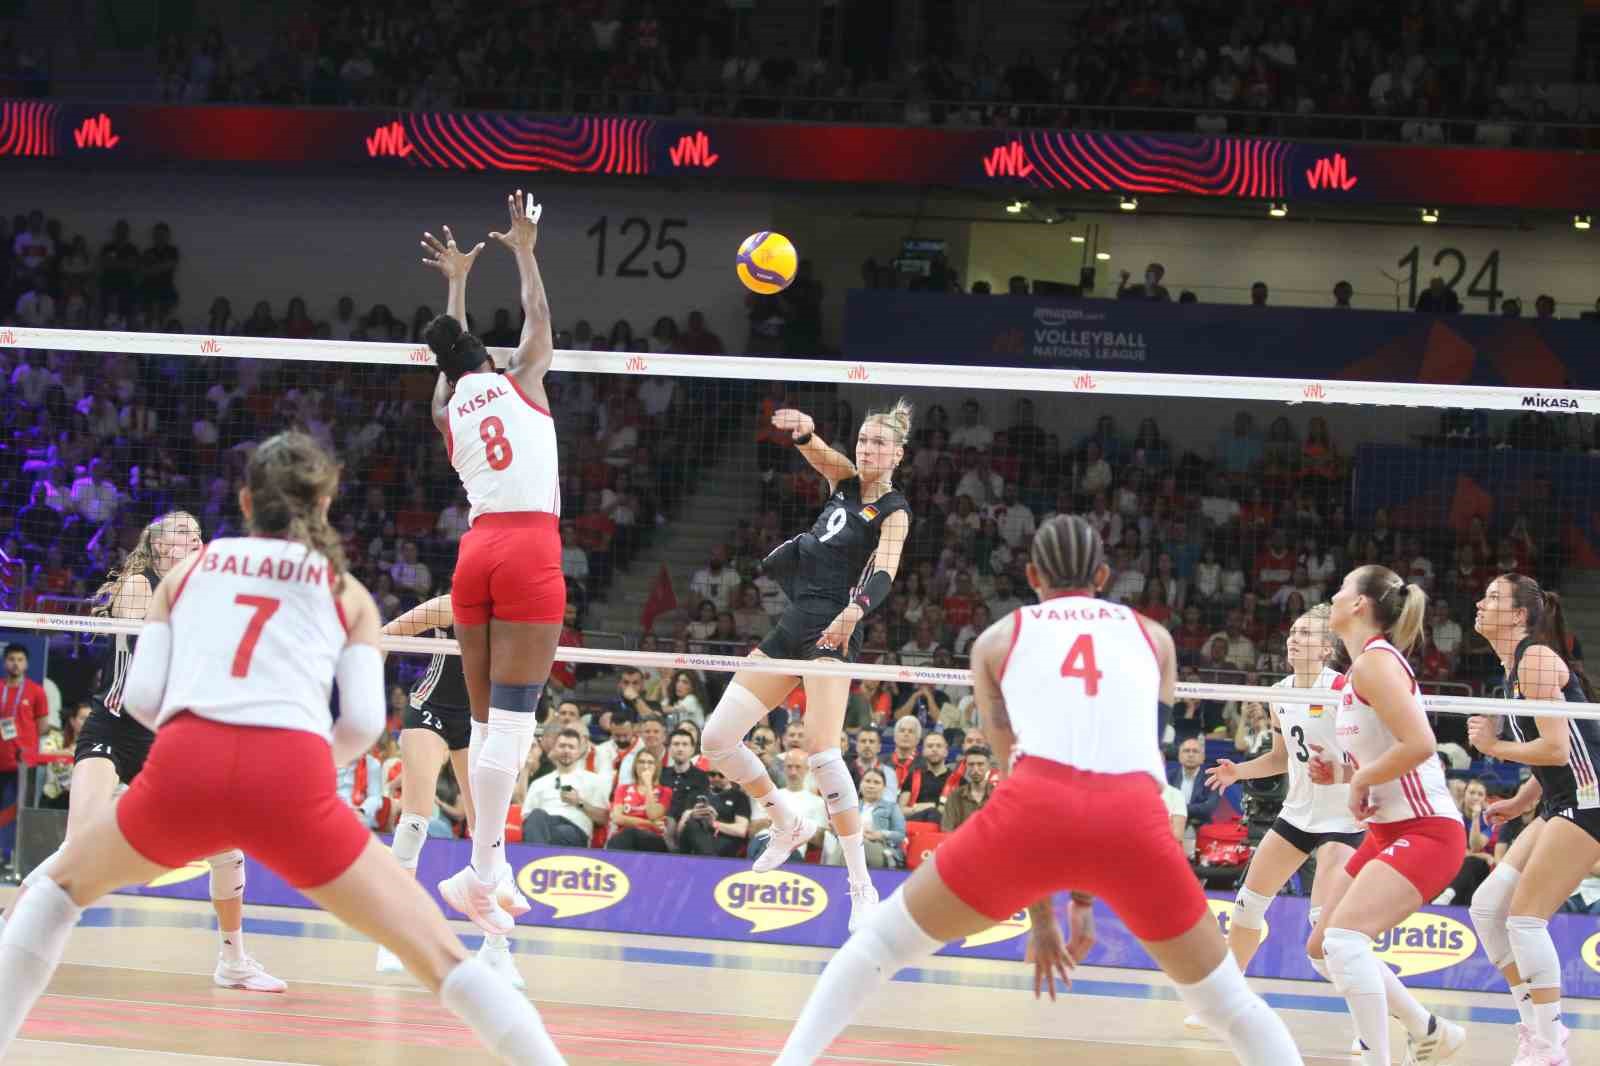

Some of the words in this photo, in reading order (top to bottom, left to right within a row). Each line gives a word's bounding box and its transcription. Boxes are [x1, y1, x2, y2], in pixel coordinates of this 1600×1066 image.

[73, 113, 120, 149] VNL
[366, 121, 413, 157] VNL
[669, 131, 719, 168] VNL
[984, 140, 1034, 177] VNL
[1306, 153, 1358, 190] VNL
[587, 216, 688, 279] 125
[1396, 244, 1504, 312] 124
[1032, 345, 1091, 359] NATIONS
[1095, 349, 1147, 361] LEAGUE
[1033, 328, 1147, 348] VOLLEYBALL
[457, 386, 509, 417] KISAL
[480, 416, 513, 471] 8
[819, 507, 847, 543] 9
[1030, 607, 1127, 620] VARGAS
[231, 594, 281, 678] 7
[1060, 633, 1103, 697] 4
[421, 710, 443, 730] 23
[1290, 725, 1310, 763] 3
[530, 865, 617, 894] gratis
[727, 879, 815, 909] gratis
[1373, 921, 1464, 952] gratis
